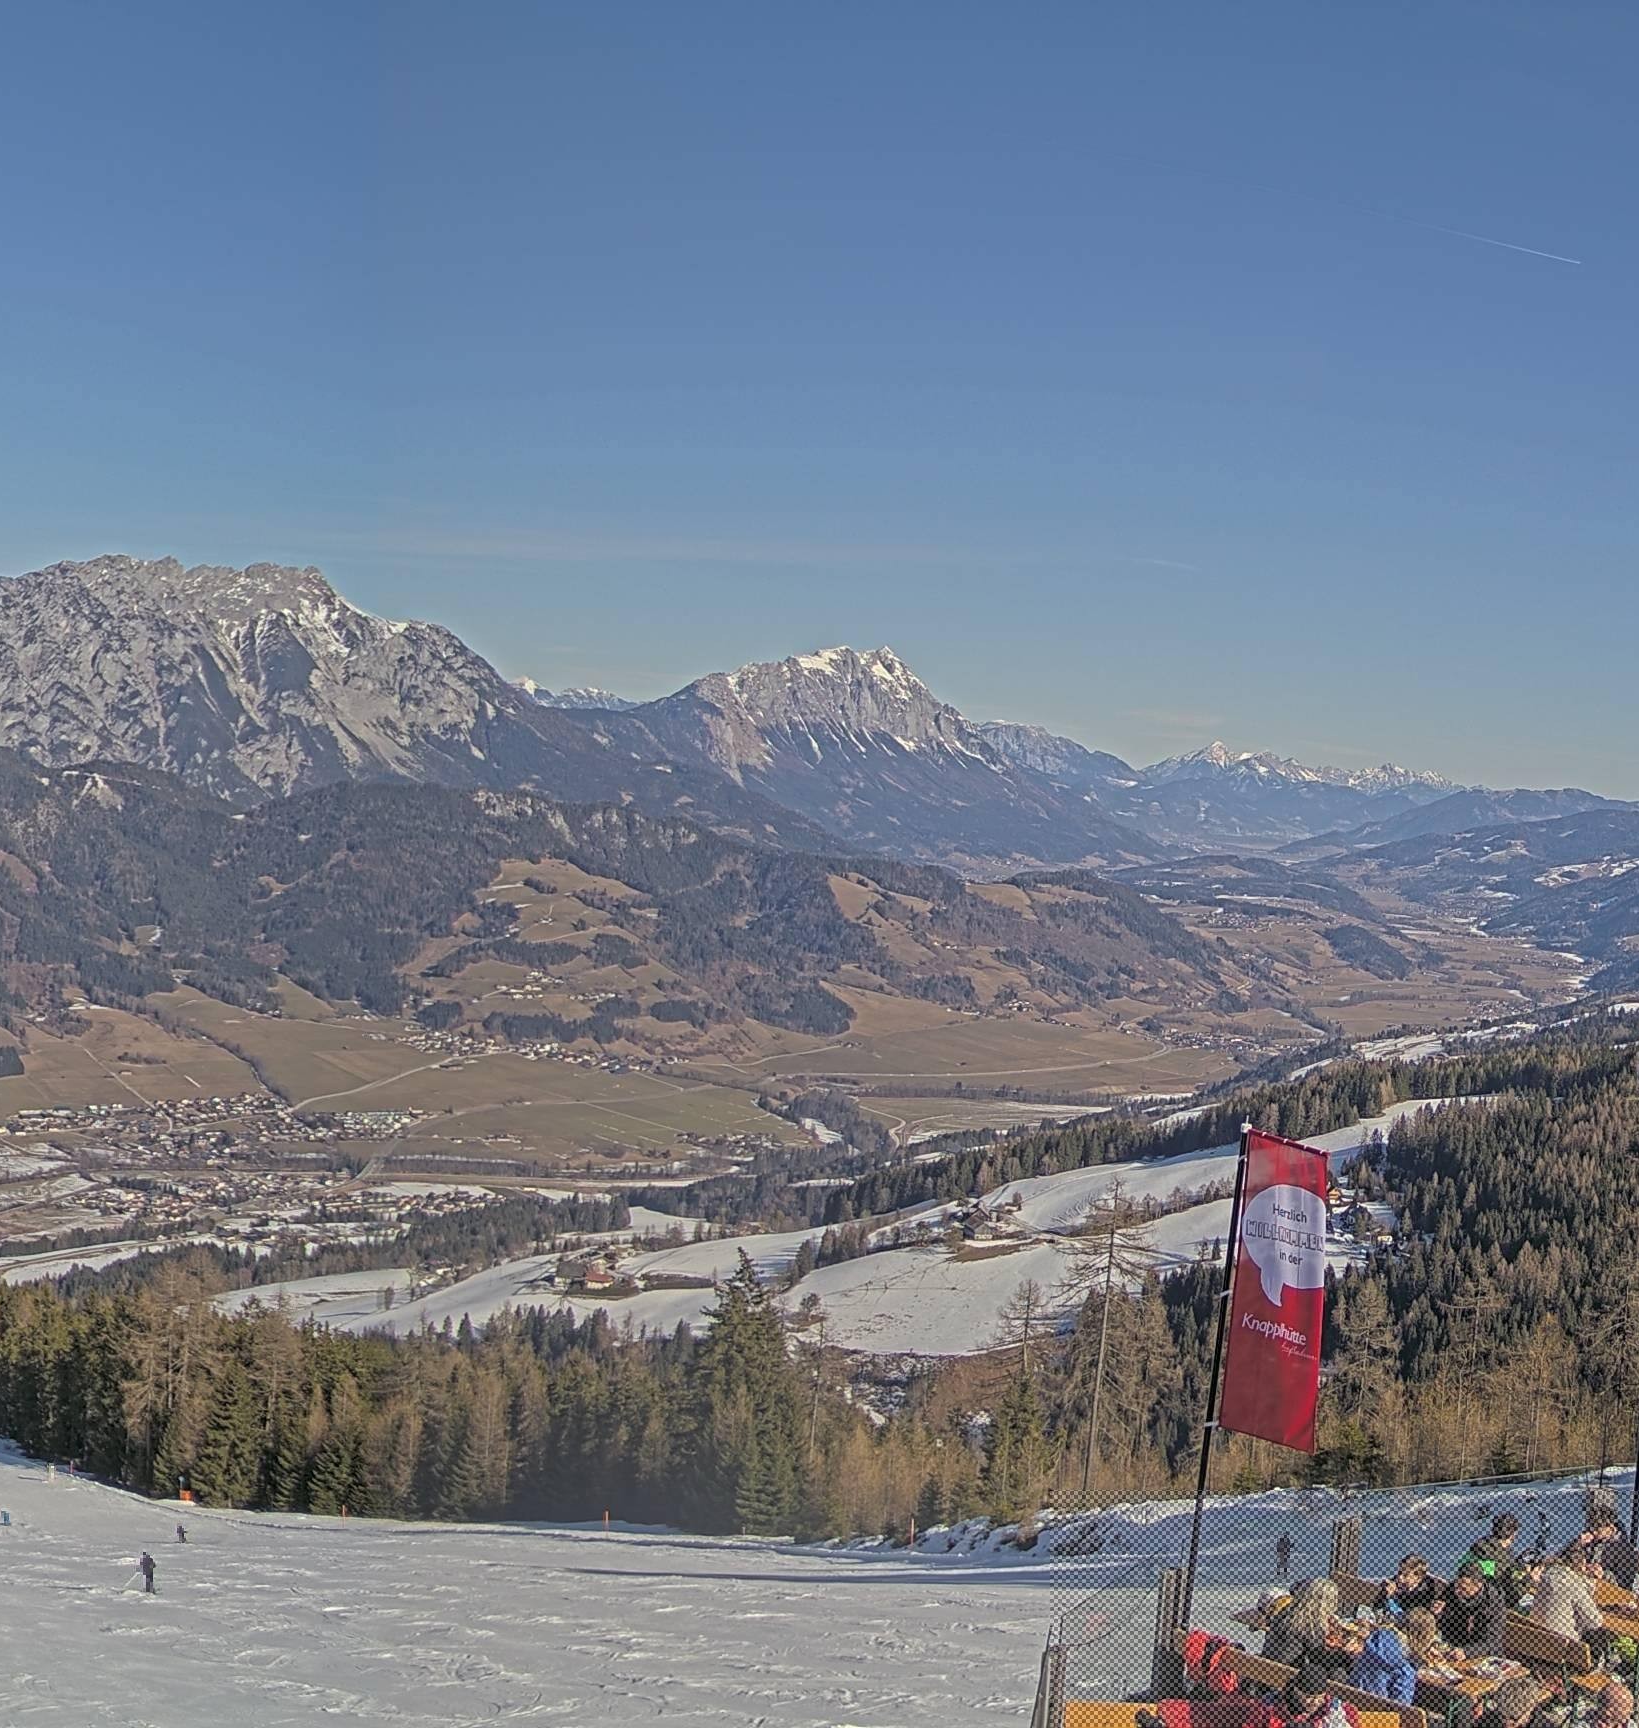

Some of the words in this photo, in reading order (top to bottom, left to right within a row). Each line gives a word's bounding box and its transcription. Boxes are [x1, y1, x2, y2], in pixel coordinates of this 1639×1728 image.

[1272, 1203, 1307, 1223] Herzlich
[1279, 1251, 1286, 1261] in
[1288, 1254, 1303, 1265] der
[1242, 1312, 1307, 1345] Knapplhütte
